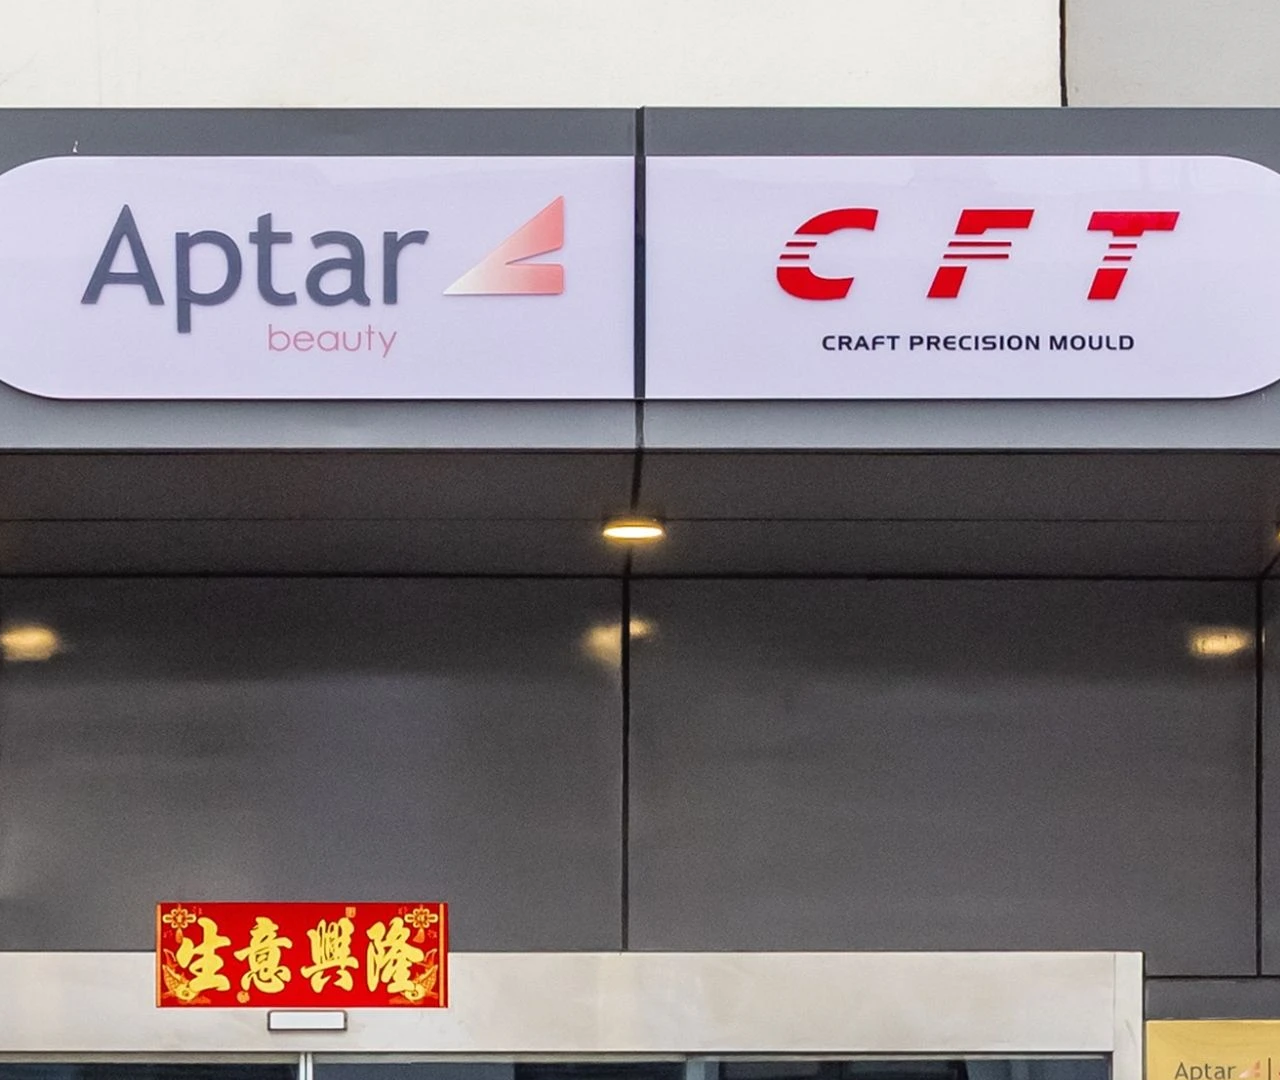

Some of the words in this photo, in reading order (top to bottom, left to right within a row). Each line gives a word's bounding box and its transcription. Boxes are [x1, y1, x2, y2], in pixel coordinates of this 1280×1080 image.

[81, 203, 431, 334] Aptar
[776, 207, 1181, 301] CFT
[267, 323, 398, 358] beauty
[821, 335, 901, 351] CRAFT
[909, 335, 1041, 351] PRECISION
[1049, 335, 1135, 351] MOULD
[176, 916, 425, 994] 生意興隆
